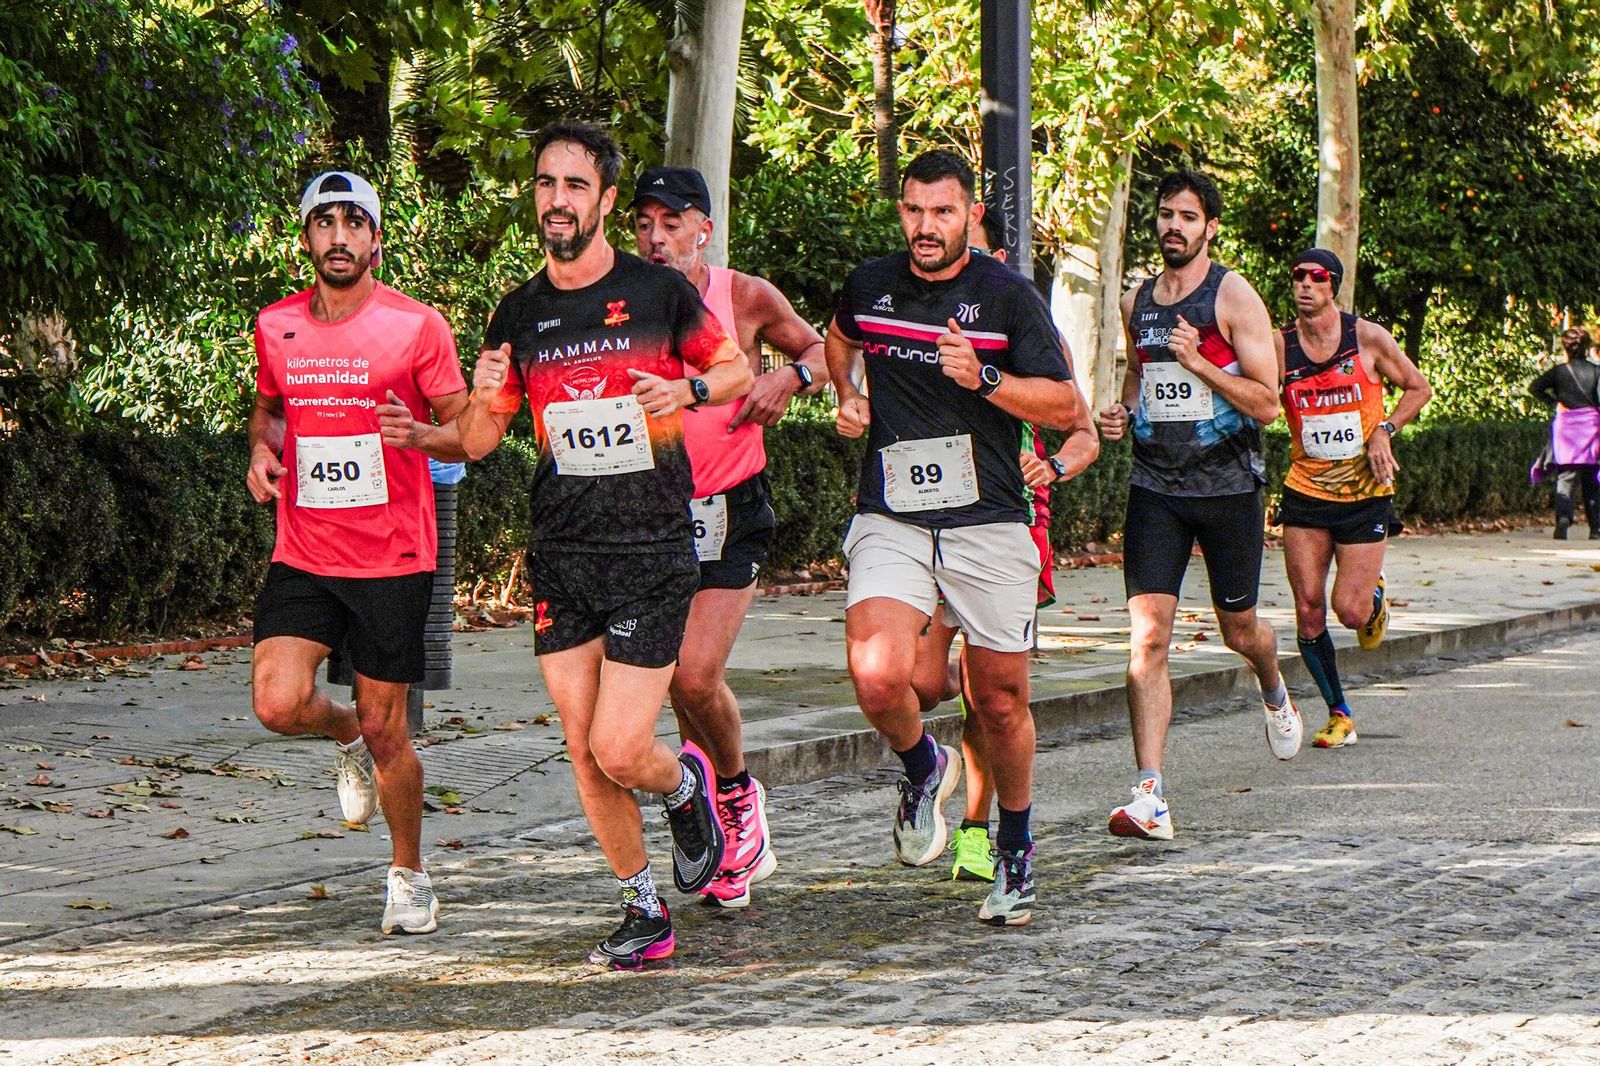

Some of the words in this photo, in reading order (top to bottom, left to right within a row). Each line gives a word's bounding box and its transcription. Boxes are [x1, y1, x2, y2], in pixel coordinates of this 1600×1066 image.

[538, 337, 631, 363] HAMMAM
[286, 357, 350, 369] kilómetros
[352, 357, 370, 369] de
[286, 370, 369, 385] humanidad
[1155, 382, 1192, 400] 639
[561, 423, 634, 450] 1612
[1311, 428, 1355, 444] 1746
[310, 460, 361, 482] 450
[909, 463, 943, 485] 89
